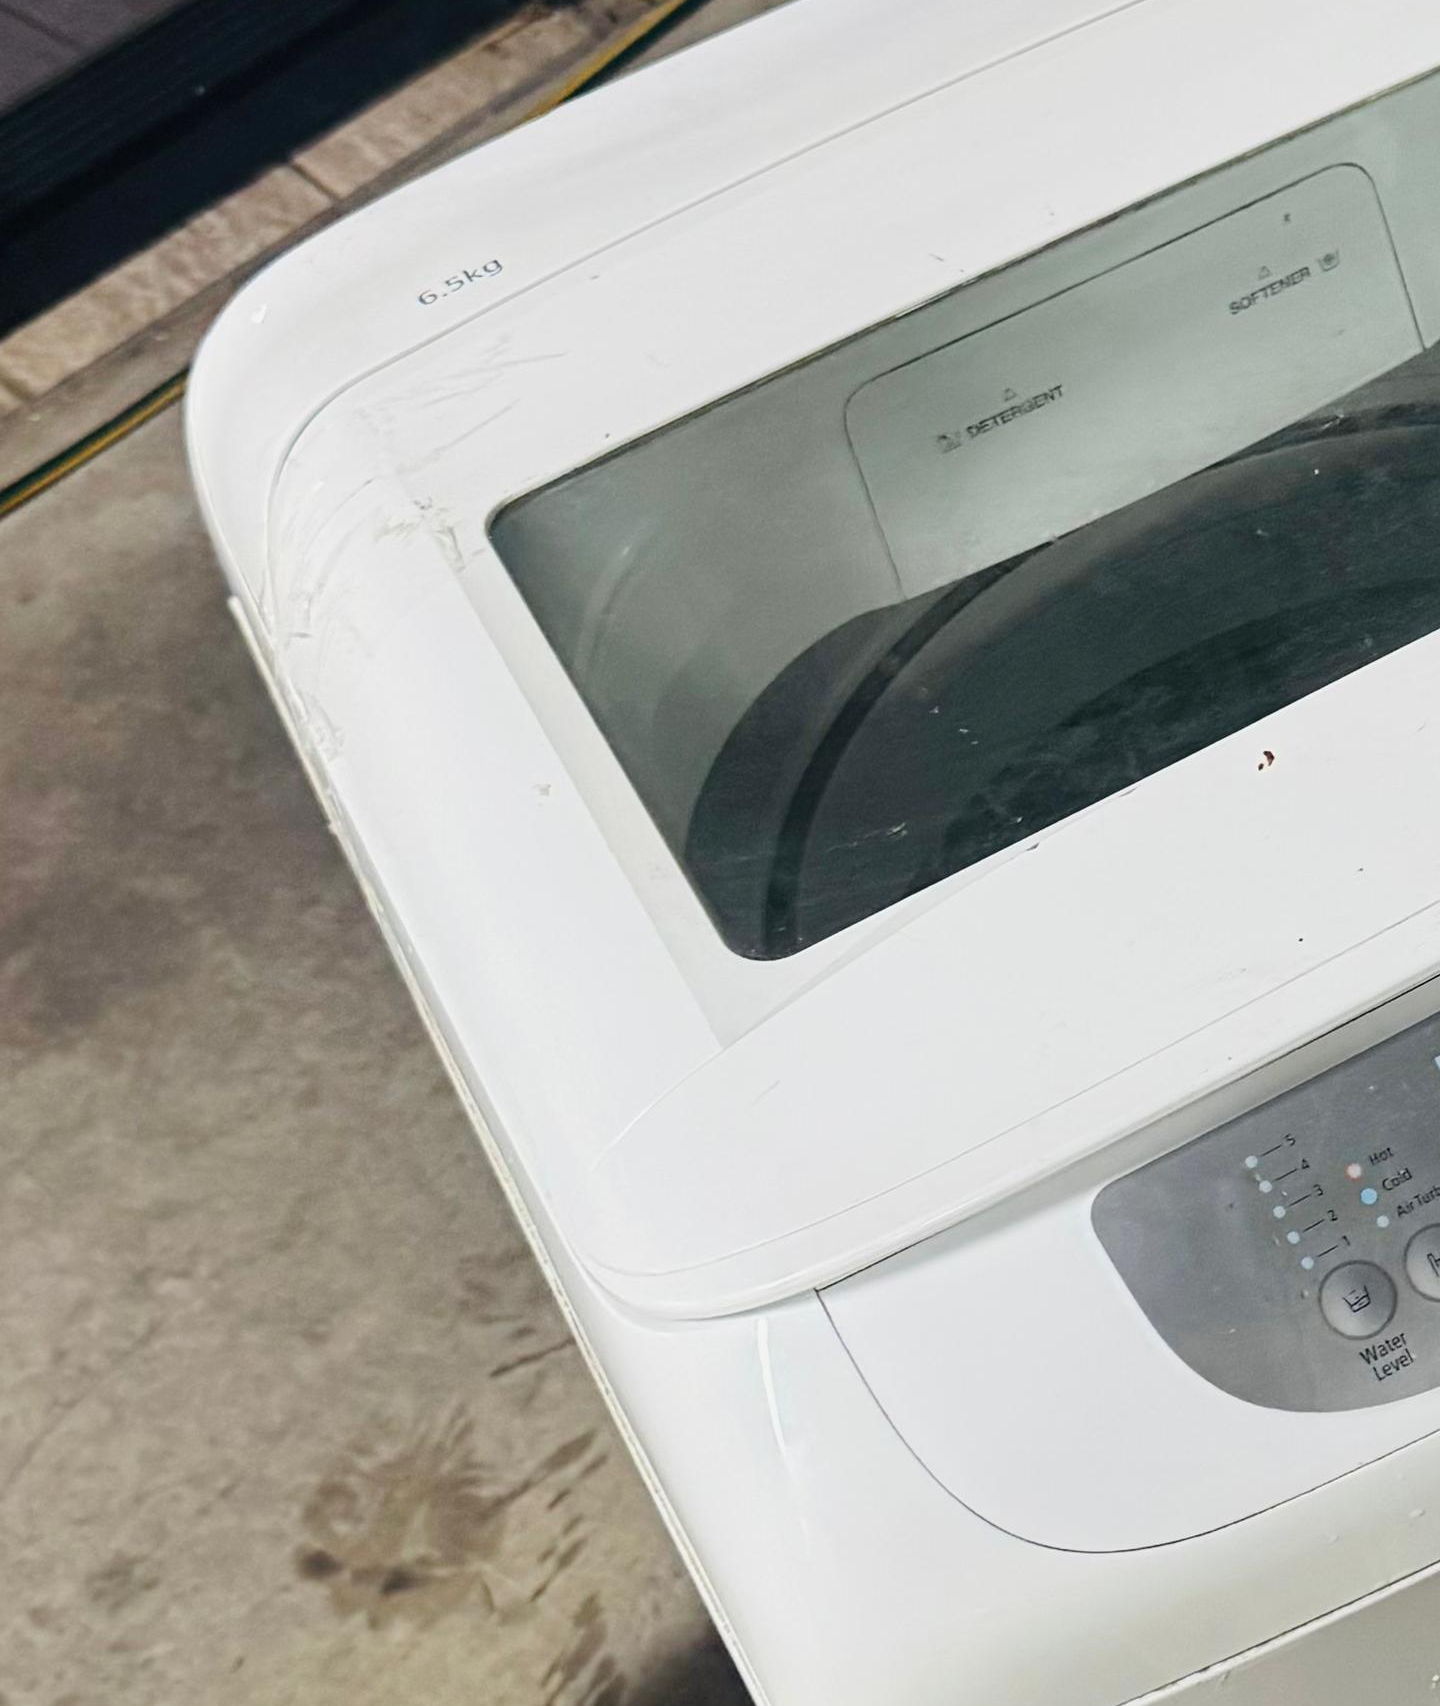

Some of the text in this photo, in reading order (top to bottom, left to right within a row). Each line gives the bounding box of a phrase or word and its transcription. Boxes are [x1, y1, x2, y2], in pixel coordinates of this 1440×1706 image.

[417, 259, 503, 305] 6.5kg
[1229, 266, 1312, 315] SOFTENER
[966, 383, 1064, 439] DETERGENT
[1286, 1133, 1297, 1147] 5
[1301, 1158, 1311, 1171] 4
[1368, 1147, 1394, 1166] Hot
[1382, 1168, 1412, 1191] Cold
[1313, 1184, 1324, 1197] 3
[1328, 1209, 1339, 1222] 2
[1397, 1199, 1415, 1217] Air
[1359, 1332, 1408, 1366] Water
[1373, 1349, 1414, 1382] Level
